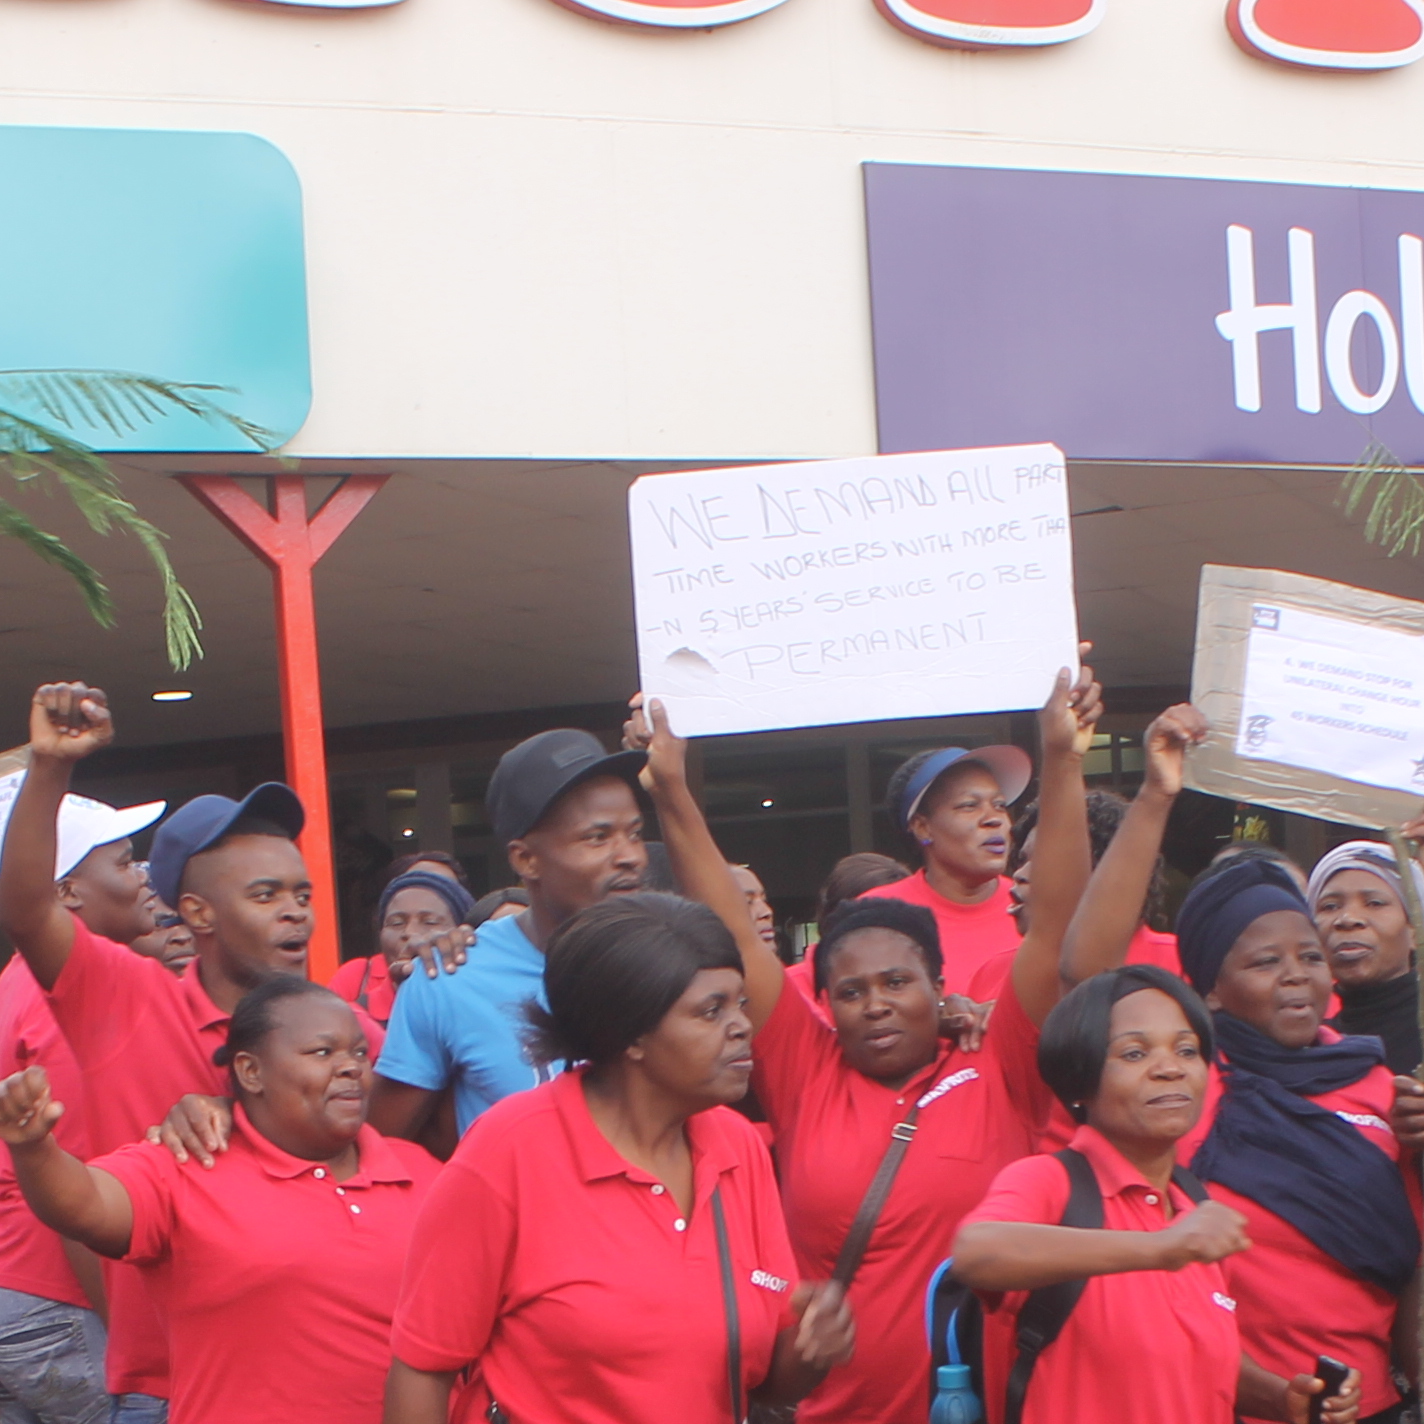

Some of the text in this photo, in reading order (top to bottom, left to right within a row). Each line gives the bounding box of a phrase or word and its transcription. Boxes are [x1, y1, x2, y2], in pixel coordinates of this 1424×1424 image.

[648, 492, 748, 550] WE
[757, 473, 938, 540] DEMAND
[1014, 463, 1067, 494] PART
[653, 563, 734, 594] TIME
[750, 541, 888, 582] WORKERS
[891, 532, 954, 559] WITH
[961, 519, 1028, 548] MORE
[813, 577, 936, 613] SERVICE
[946, 570, 987, 593] TO
[992, 562, 1047, 584] BE
[720, 611, 988, 680] PERMANENT
